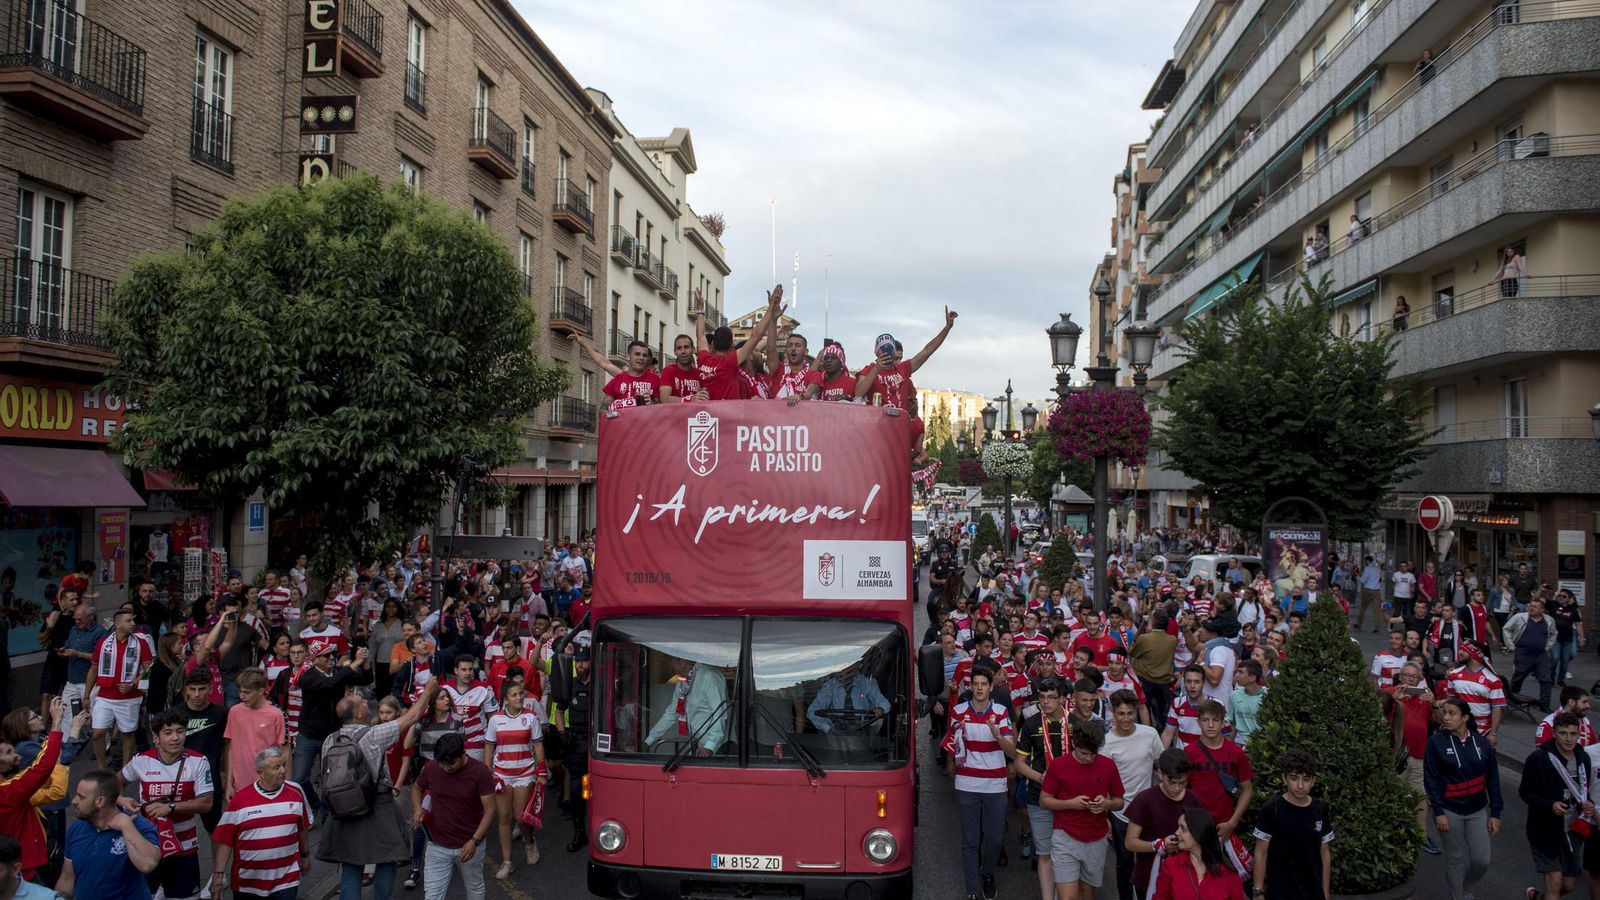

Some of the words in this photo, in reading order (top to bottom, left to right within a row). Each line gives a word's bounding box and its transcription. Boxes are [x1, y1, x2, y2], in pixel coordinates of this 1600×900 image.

[632, 381, 652, 389] PASITO
[825, 388, 844, 397] PASITO
[736, 425, 809, 452] PASITO
[750, 452, 761, 472] A
[766, 452, 822, 472] PASITO
[254, 504, 261, 519] H
[694, 483, 881, 544] primera!
[1269, 531, 1321, 541] ROCKETMAN
[632, 572, 671, 585] 2018/19
[858, 570, 892, 579] CERVEZAS
[856, 579, 893, 588] ALHAMBRA
[186, 718, 209, 729] NIKE
[718, 856, 726, 867] M
[731, 857, 760, 869] 8152
[765, 858, 780, 869] ZD
